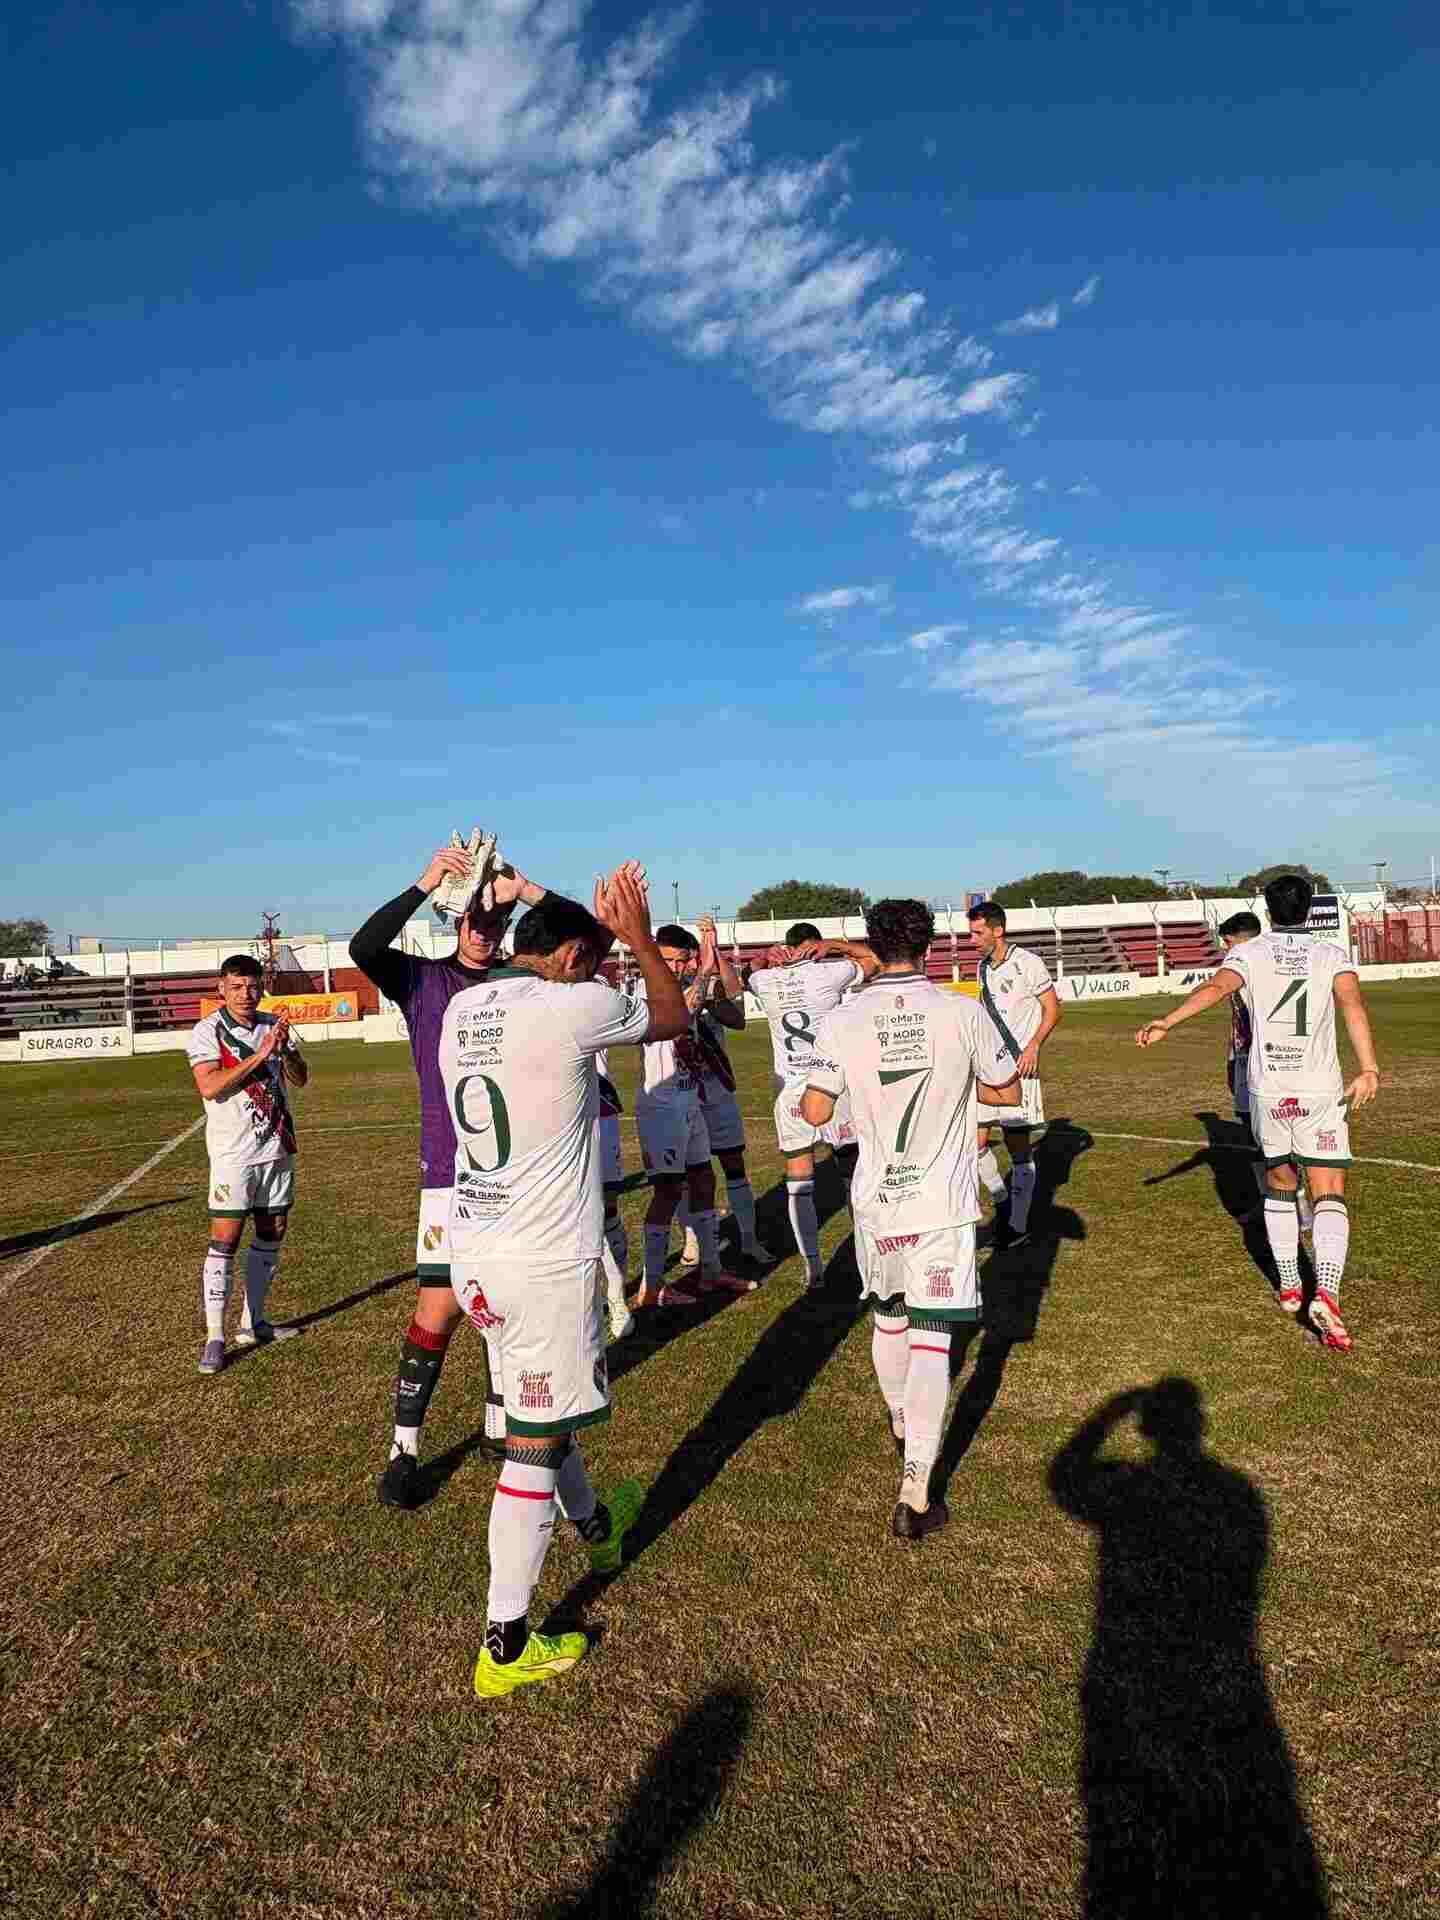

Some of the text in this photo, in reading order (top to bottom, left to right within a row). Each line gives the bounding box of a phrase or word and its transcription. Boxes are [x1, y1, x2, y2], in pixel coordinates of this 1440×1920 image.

[1089, 980, 1130, 993] VALOR
[1266, 979, 1312, 1036] 4
[472, 1027, 504, 1039] MORO
[893, 1028, 926, 1040] MORO
[27, 1037, 94, 1050] SURAGRO
[878, 1067, 933, 1153] 7
[455, 1074, 511, 1172] 9
